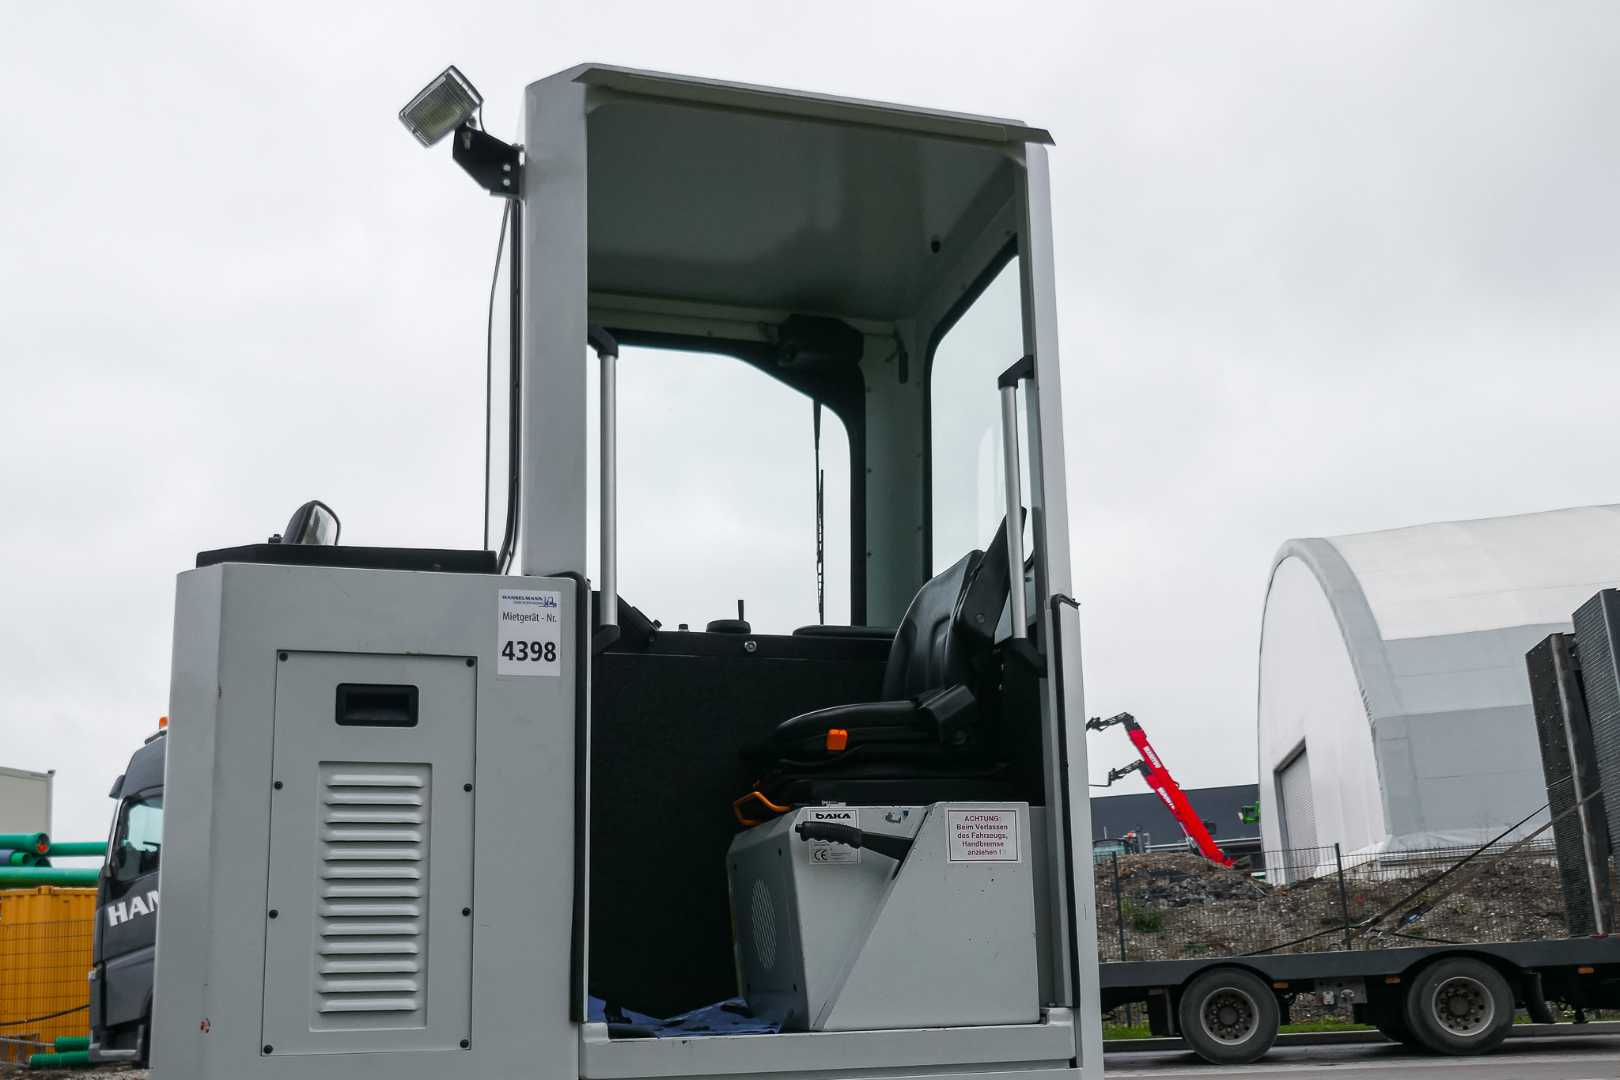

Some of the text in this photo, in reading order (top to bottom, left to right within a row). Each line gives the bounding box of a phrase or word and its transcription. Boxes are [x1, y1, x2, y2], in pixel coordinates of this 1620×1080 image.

[502, 611, 539, 624] Mietgerät
[546, 613, 557, 623] Nr.
[501, 640, 557, 662] 4398
